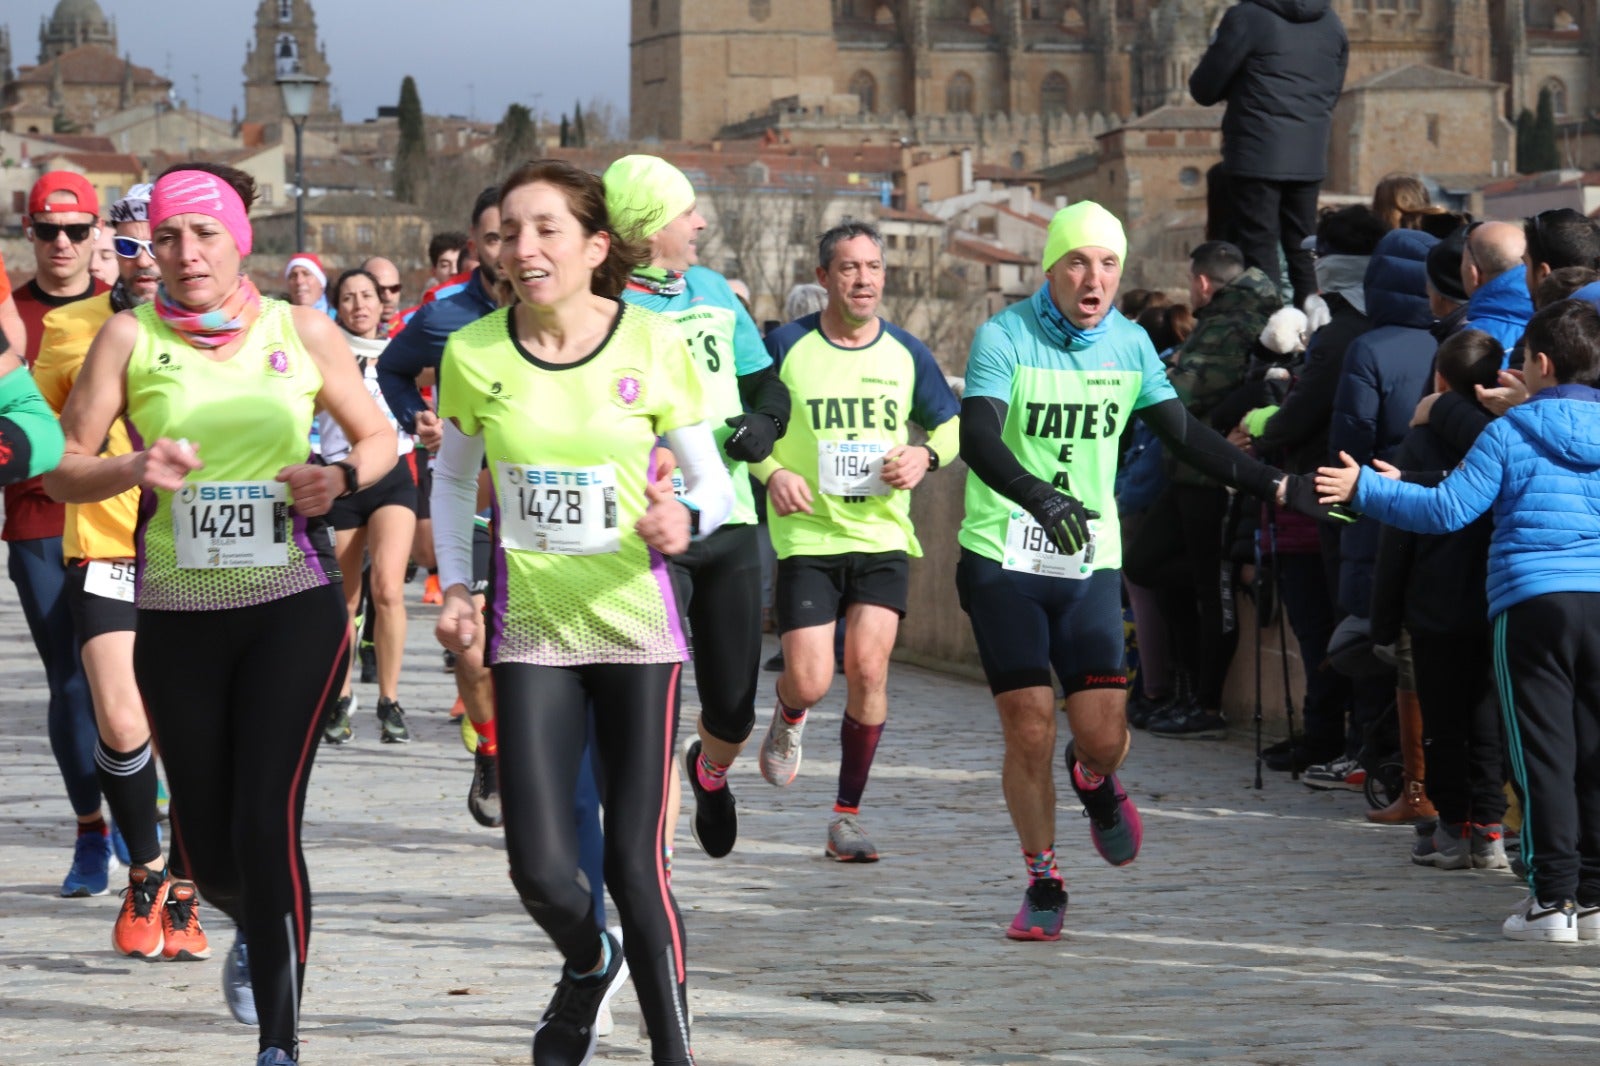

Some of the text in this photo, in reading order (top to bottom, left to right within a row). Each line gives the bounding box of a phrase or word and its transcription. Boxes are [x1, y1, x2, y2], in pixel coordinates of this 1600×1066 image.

[839, 443, 885, 453] SETEL
[835, 455, 870, 477] 1194
[526, 470, 602, 487] SETEL
[200, 486, 275, 500] SETEL
[518, 486, 582, 524] 1428
[190, 503, 255, 539] 1429
